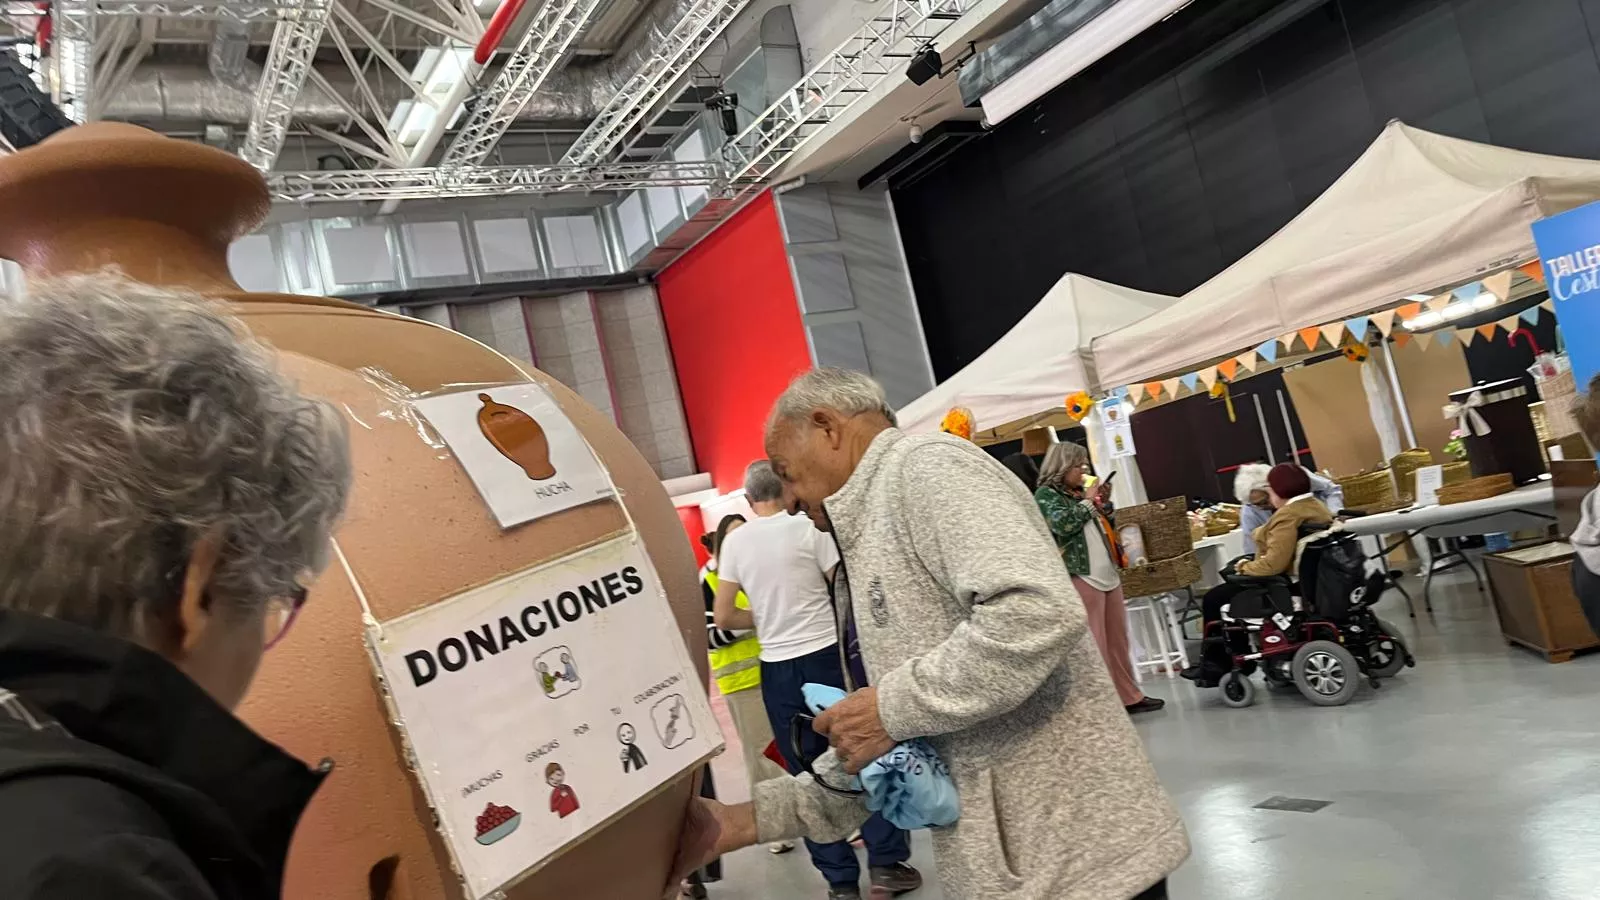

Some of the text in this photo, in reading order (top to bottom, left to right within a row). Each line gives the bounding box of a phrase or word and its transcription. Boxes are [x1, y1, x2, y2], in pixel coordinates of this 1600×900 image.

[533, 481, 573, 500] HUCHA
[404, 566, 643, 687] DONACIONES
[525, 738, 560, 763] GRACIAS
[573, 722, 591, 737] POR
[609, 703, 621, 716] TU
